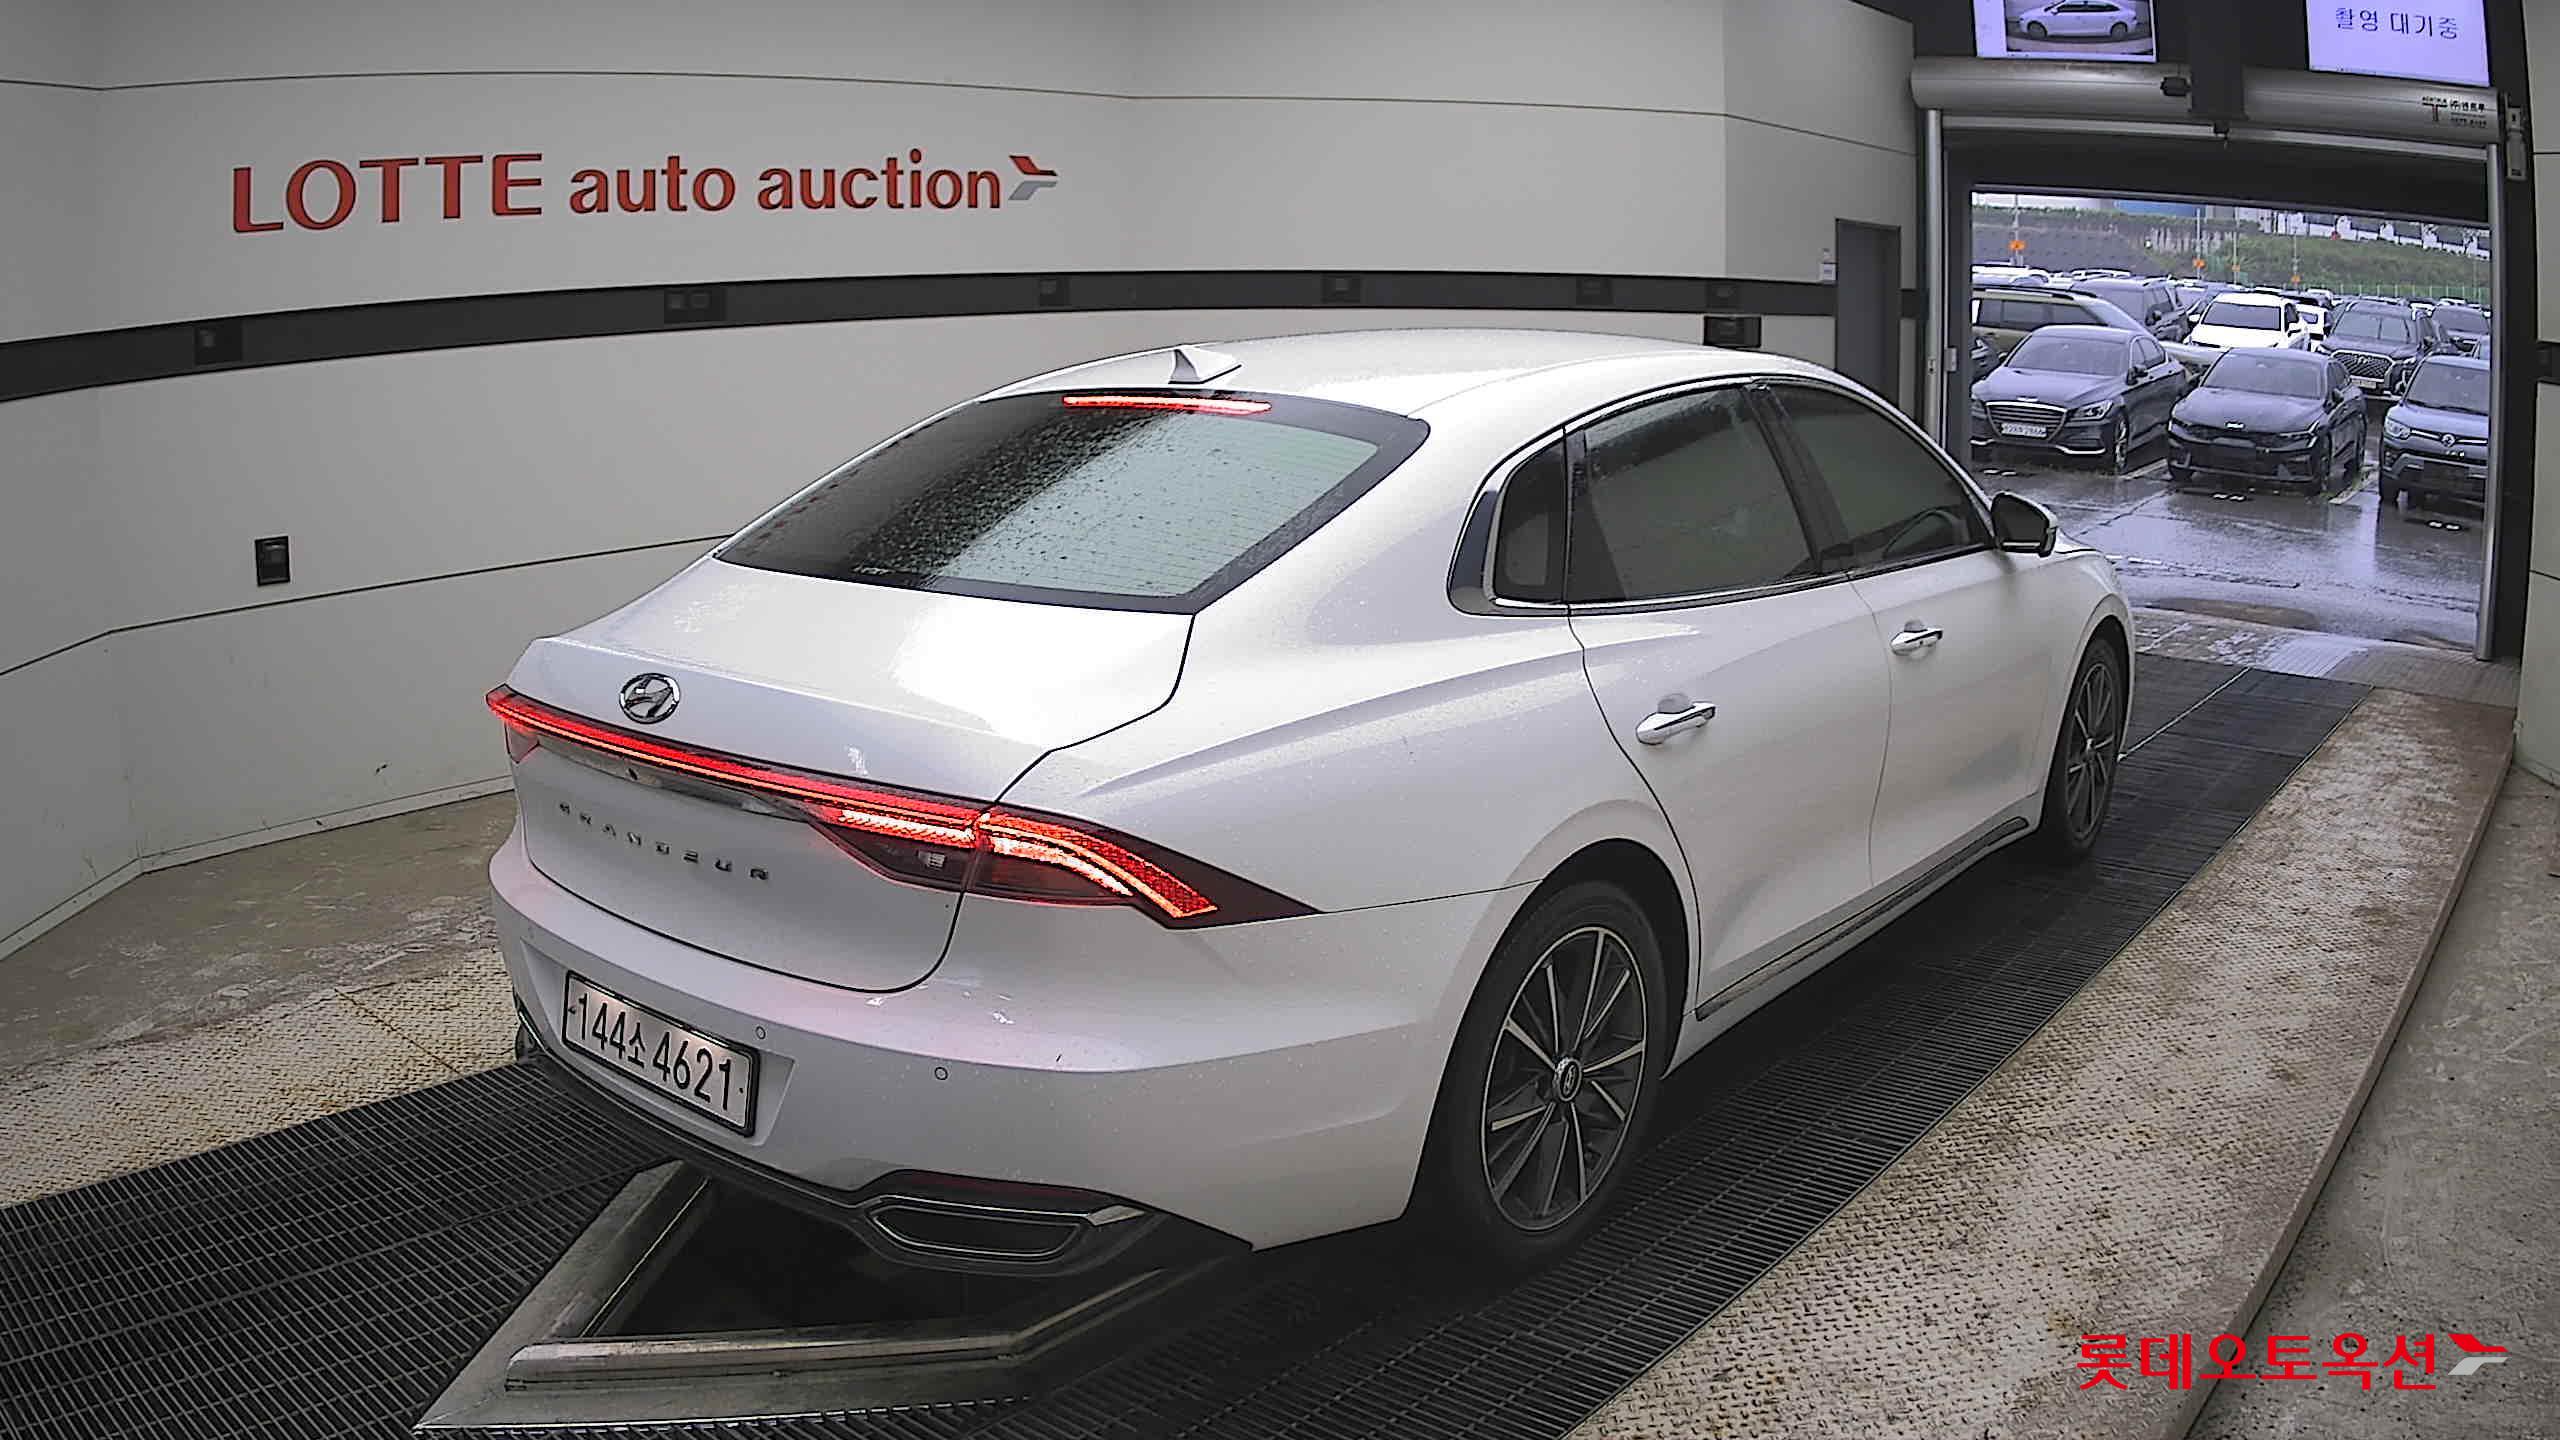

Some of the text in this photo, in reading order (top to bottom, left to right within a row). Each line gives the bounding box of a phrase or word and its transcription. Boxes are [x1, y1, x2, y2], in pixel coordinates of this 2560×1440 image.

[2390, 12, 2458, 40] 대기중
[232, 149, 1001, 233] LOTTE auto auction
